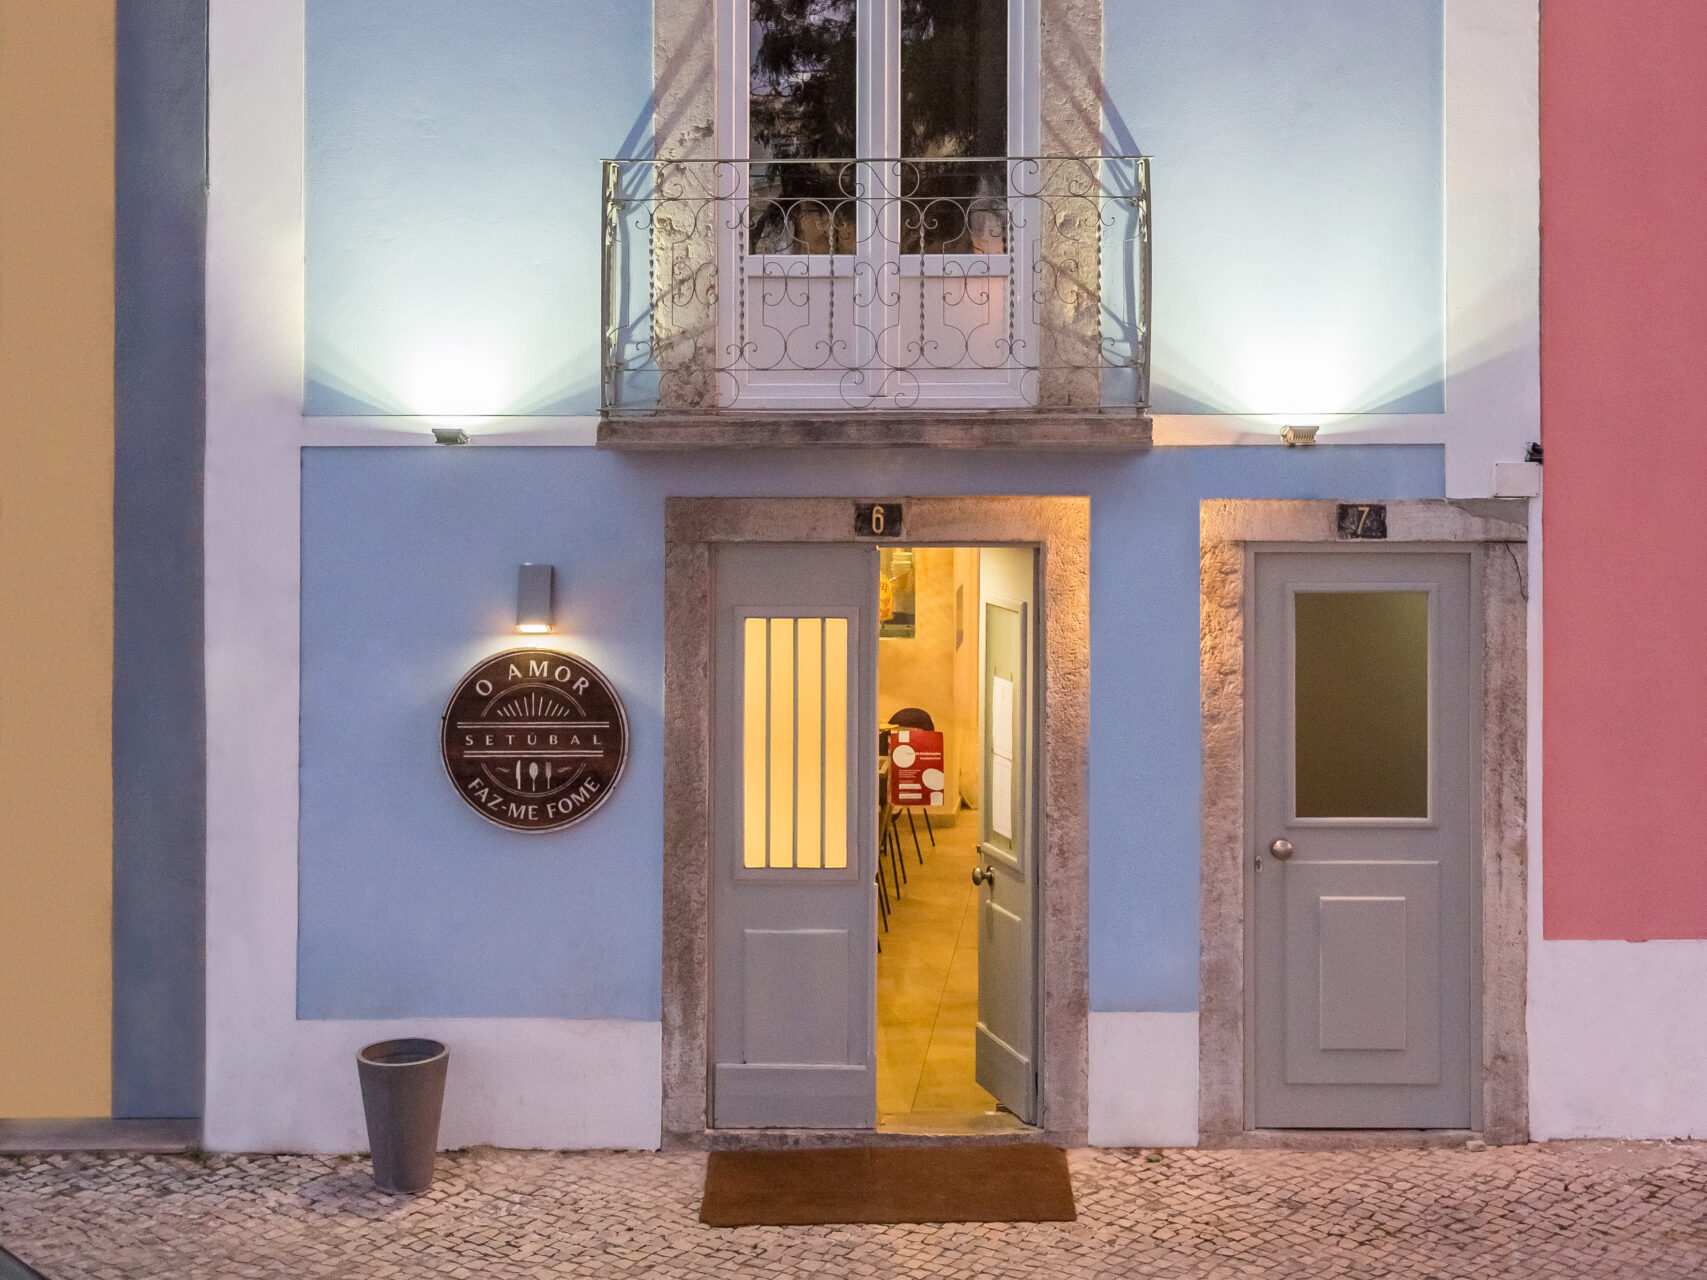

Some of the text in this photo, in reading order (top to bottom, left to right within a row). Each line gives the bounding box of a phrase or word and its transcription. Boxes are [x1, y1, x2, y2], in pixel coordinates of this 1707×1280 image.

[872, 505, 884, 534] 6
[1357, 506, 1370, 535] 7
[475, 660, 590, 696] O AMOR
[465, 732, 602, 746] SETÚBAL
[467, 776, 600, 820] FAZ-ME FOME
